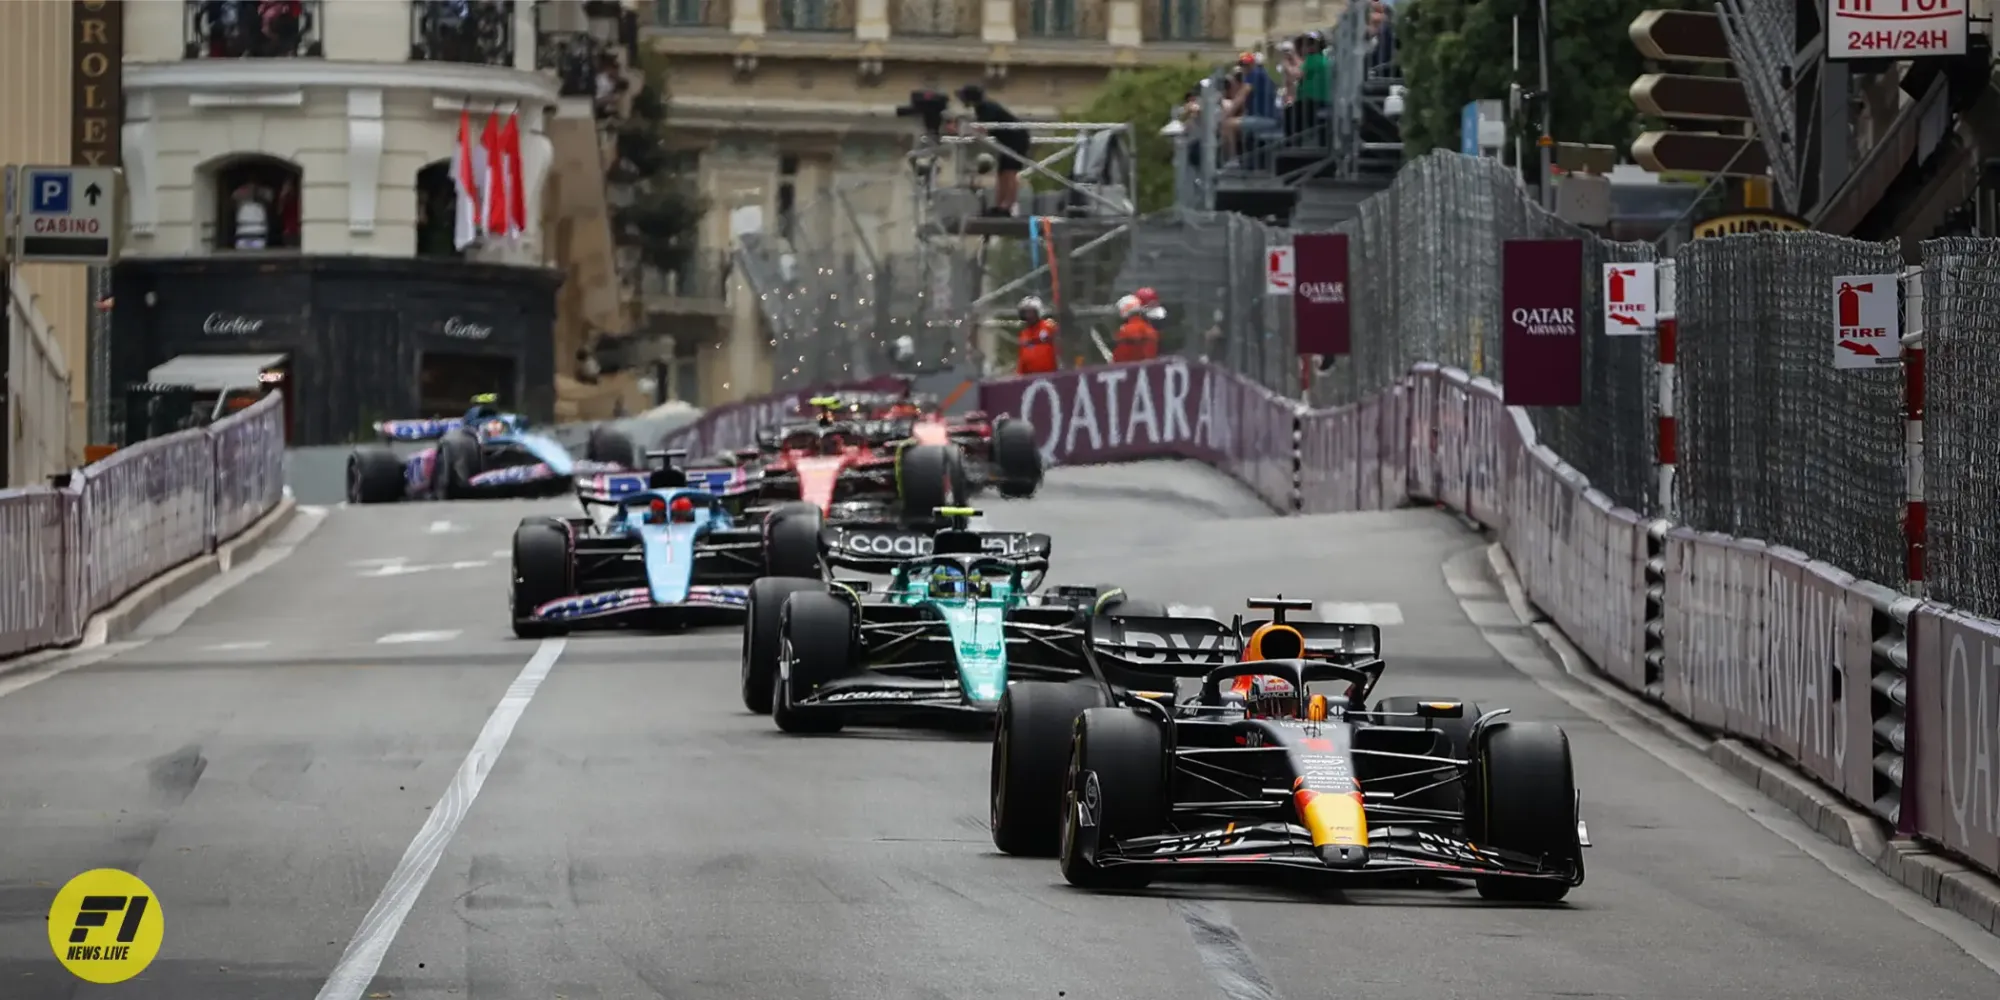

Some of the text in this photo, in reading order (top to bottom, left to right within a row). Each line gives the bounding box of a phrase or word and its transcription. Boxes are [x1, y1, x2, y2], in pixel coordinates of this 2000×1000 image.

[1847, 29, 1948, 50] 24H/24H
[80, 19, 108, 167] ROLEX
[42, 180, 62, 206] P
[34, 217, 100, 234] CASINO
[1300, 281, 1344, 297] QATAR
[1512, 307, 1575, 327] QATAR
[1608, 303, 1646, 312] FIRE
[203, 311, 263, 335] Cartier
[444, 315, 494, 340] Cartier
[1526, 324, 1576, 335] AIRWAYS
[1839, 327, 1887, 338] FIRE
